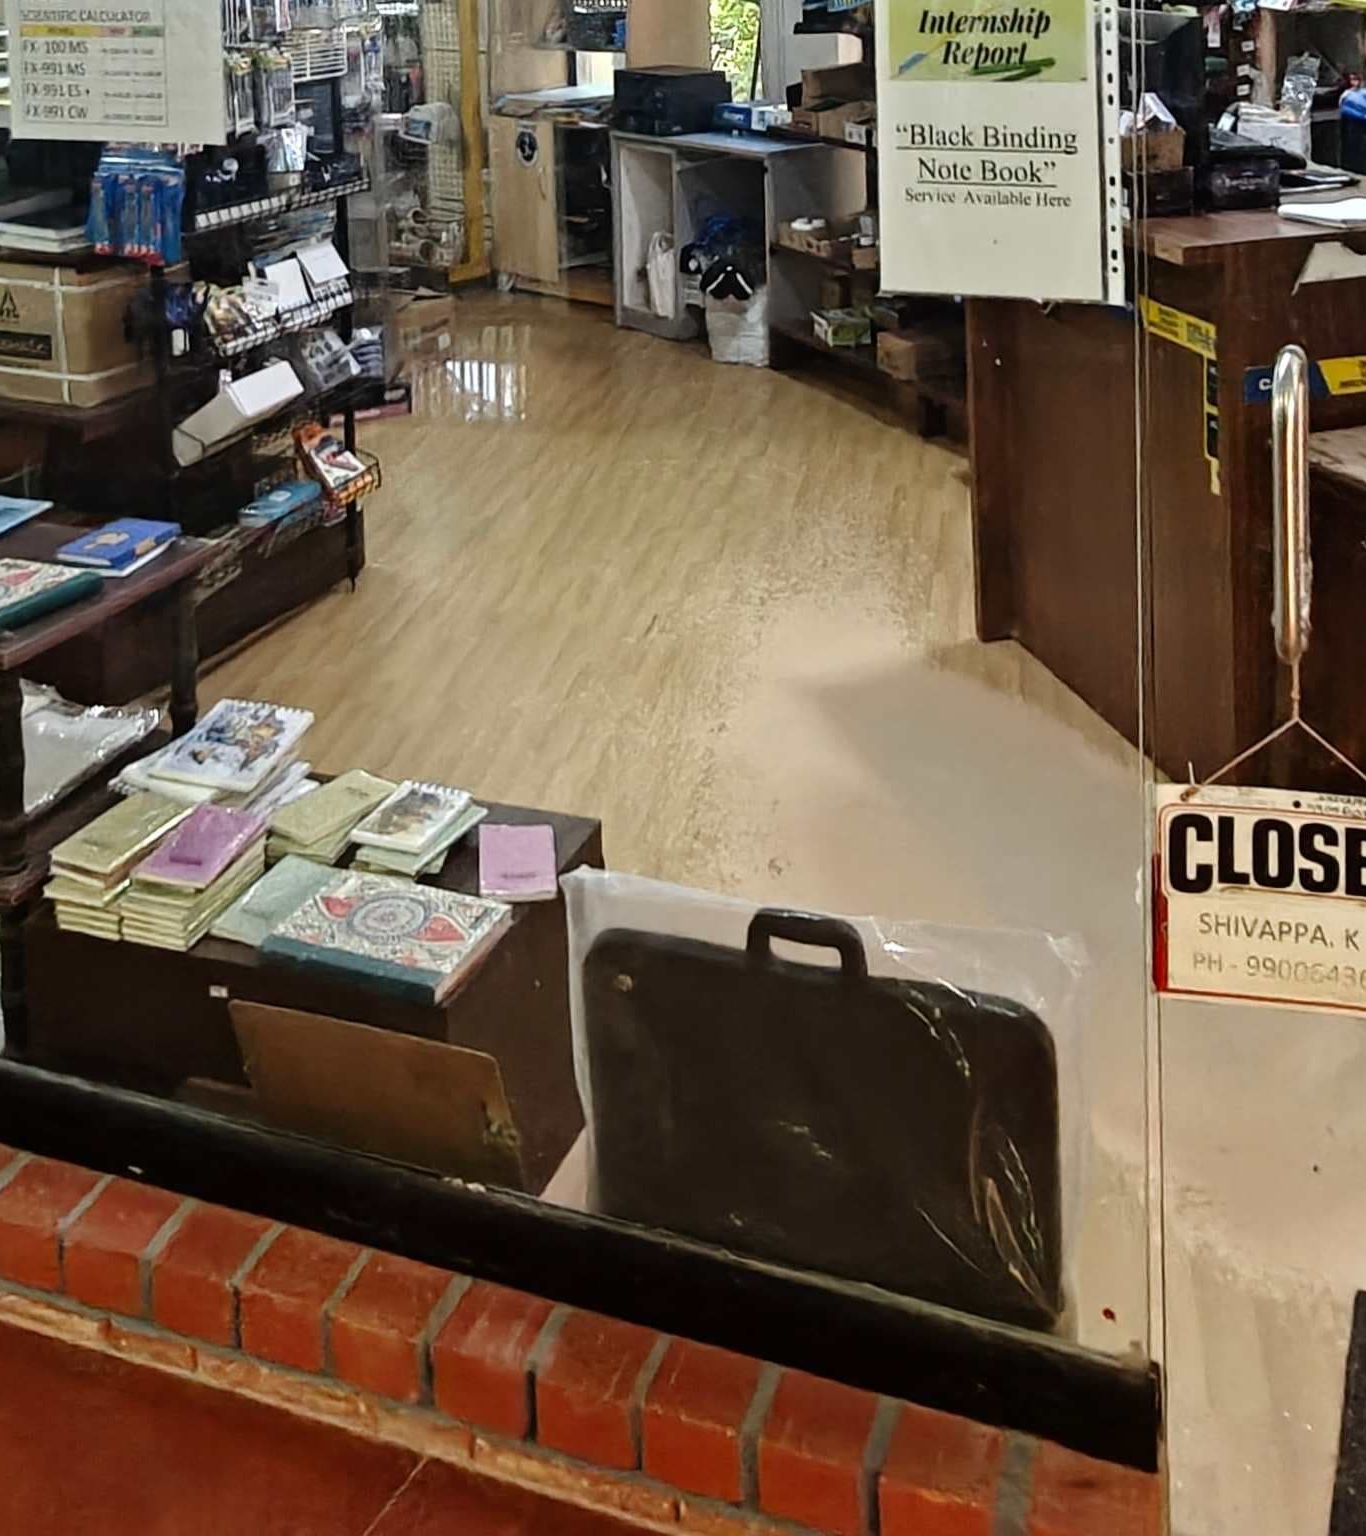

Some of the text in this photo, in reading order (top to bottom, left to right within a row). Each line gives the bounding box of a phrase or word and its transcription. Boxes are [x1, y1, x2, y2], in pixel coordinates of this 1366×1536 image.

[918, 7, 1051, 40] Internship
[942, 40, 1028, 70] Report
[984, 125, 1078, 154] Binding
[918, 157, 972, 181] Note
[905, 187, 1072, 208] Service Available Here
[1345, 928, 1360, 951] K
[1192, 952, 1223, 972] PH
